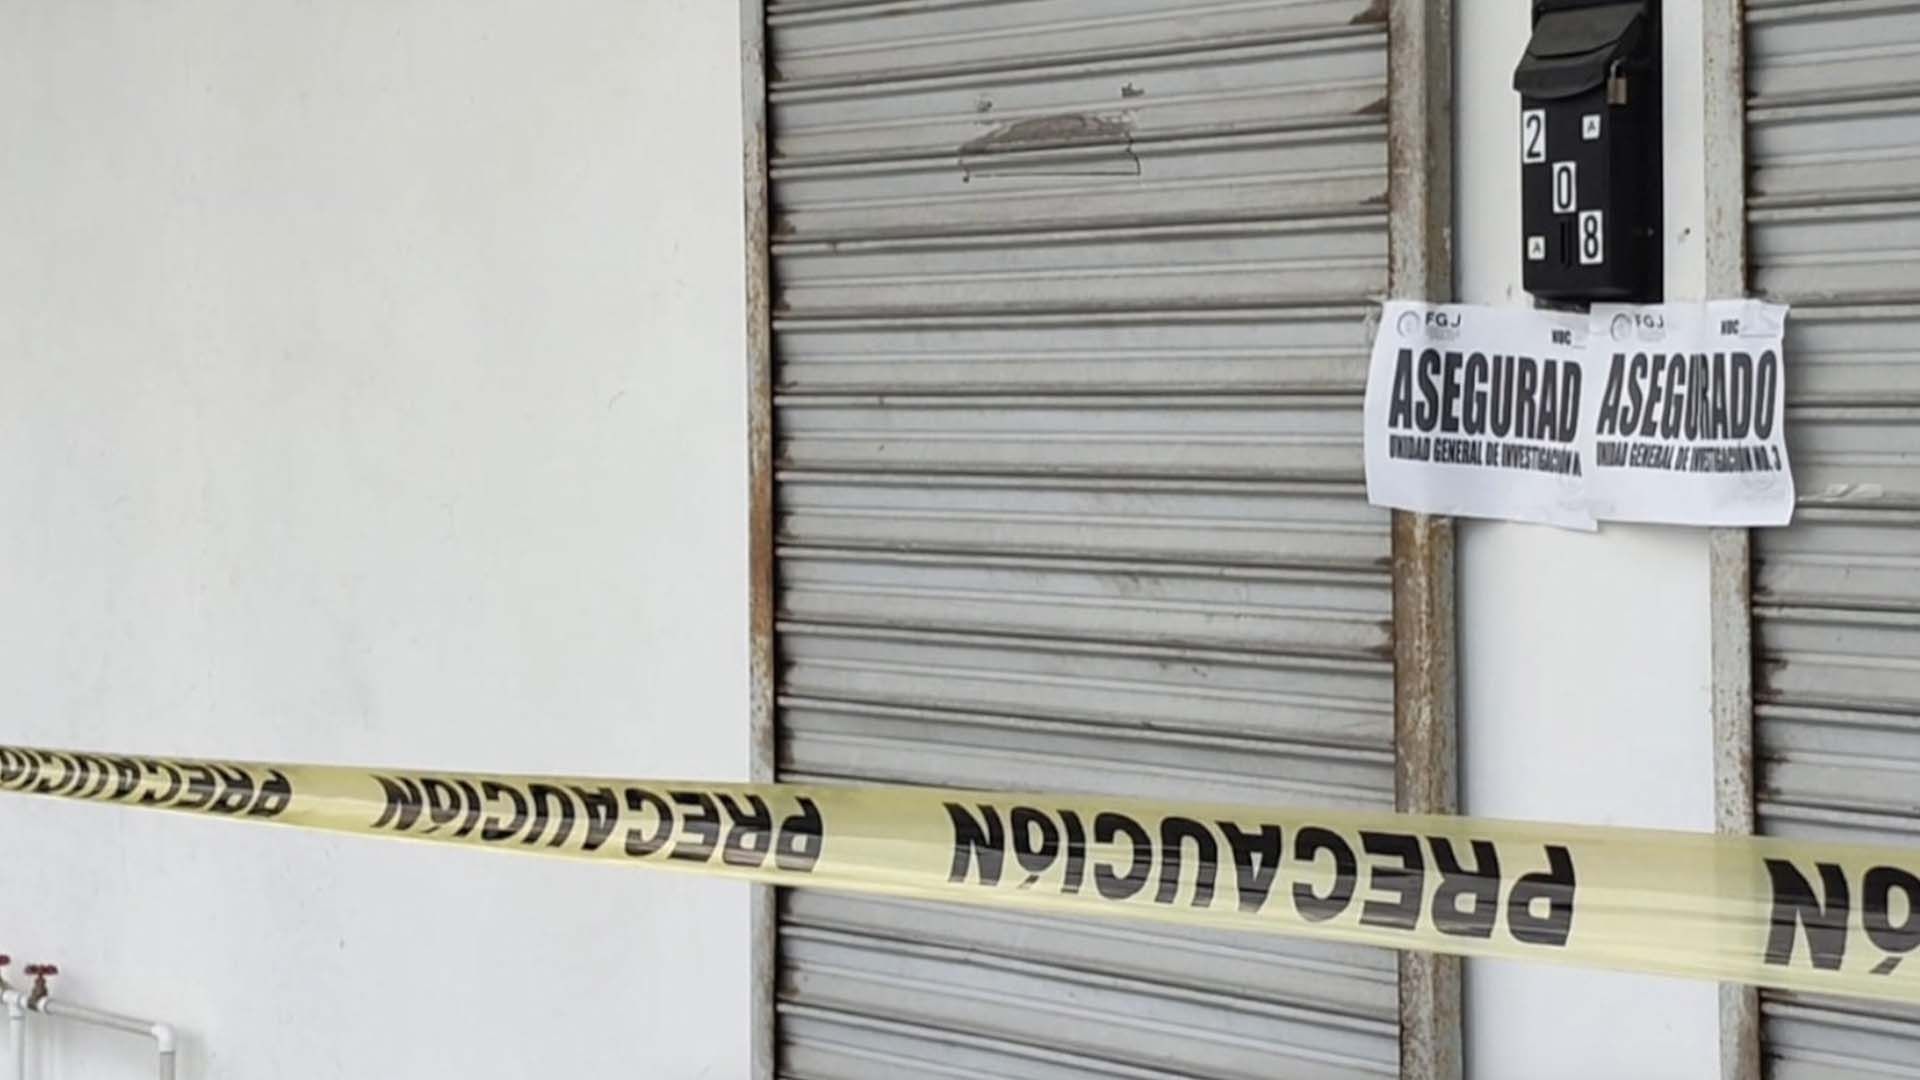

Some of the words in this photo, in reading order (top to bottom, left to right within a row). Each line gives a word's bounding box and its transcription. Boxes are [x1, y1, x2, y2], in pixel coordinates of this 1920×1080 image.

[1526, 113, 1542, 159] 2
[1586, 119, 1597, 134] A
[1583, 214, 1600, 260] 8
[1425, 311, 1462, 328] FGJ
[1595, 349, 1778, 442] ASEGURADO
[1389, 434, 1431, 462] UNIDAD
[1433, 437, 1483, 466] GENERAL
[1485, 441, 1500, 467] DE
[1629, 442, 1673, 469] GENERAL
[1674, 446, 1689, 472] DE
[370, 774, 824, 873] PRECAUCIÓN
[943, 801, 1578, 947] PRECAUCIÓN
